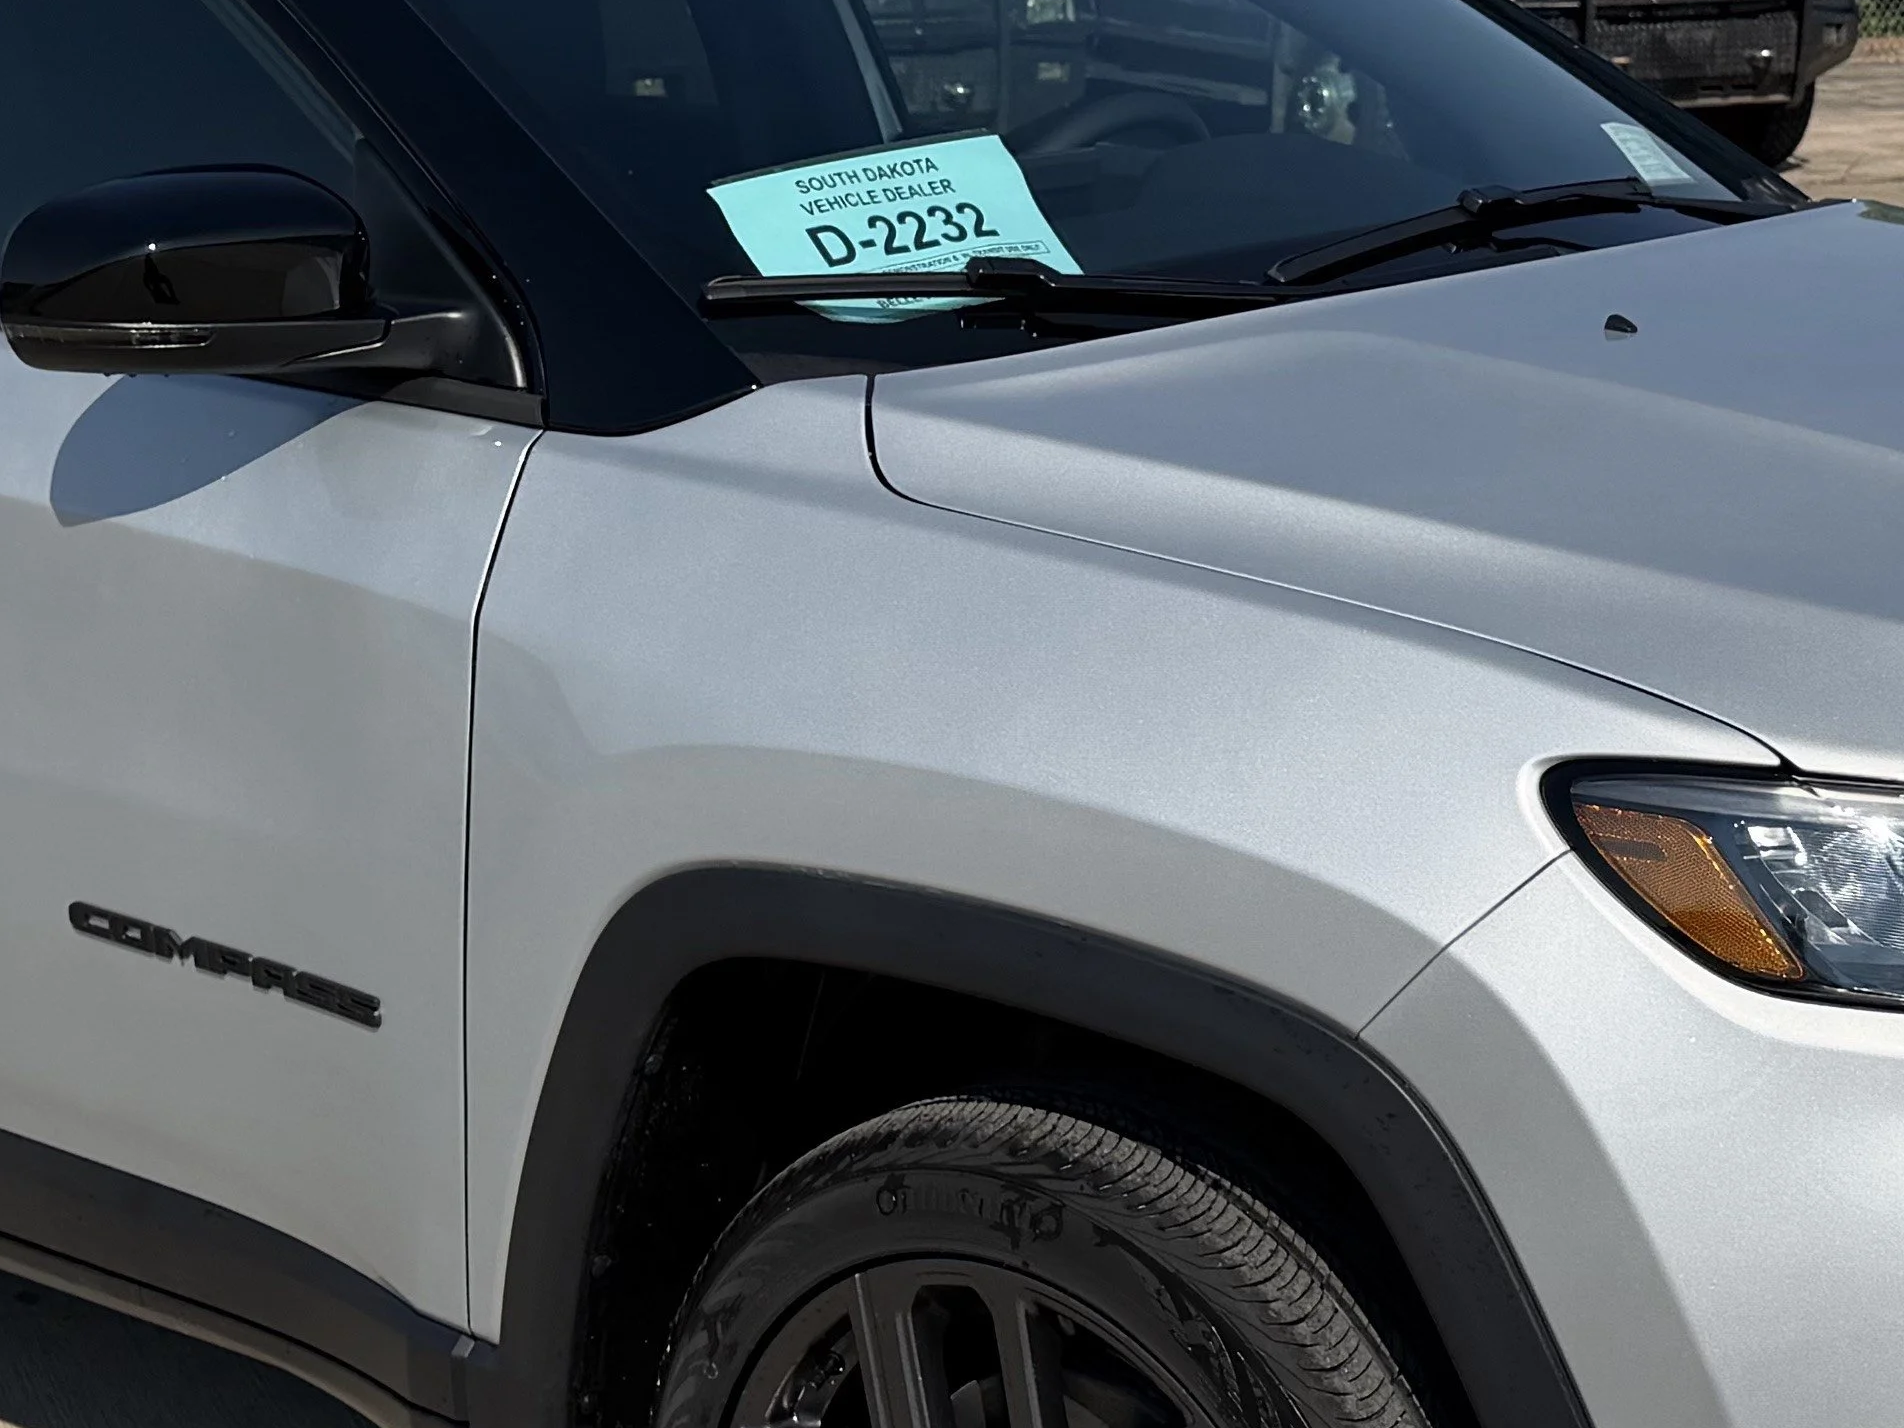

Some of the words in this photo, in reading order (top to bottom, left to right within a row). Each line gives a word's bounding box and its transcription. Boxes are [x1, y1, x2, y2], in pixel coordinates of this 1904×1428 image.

[794, 169, 861, 195] SOUTH
[861, 156, 939, 183] DAKOTA
[799, 189, 883, 217] VEHICLE
[881, 178, 957, 204] DEALER
[805, 202, 1001, 268] D-2232
[68, 900, 383, 1031] COMPASS
